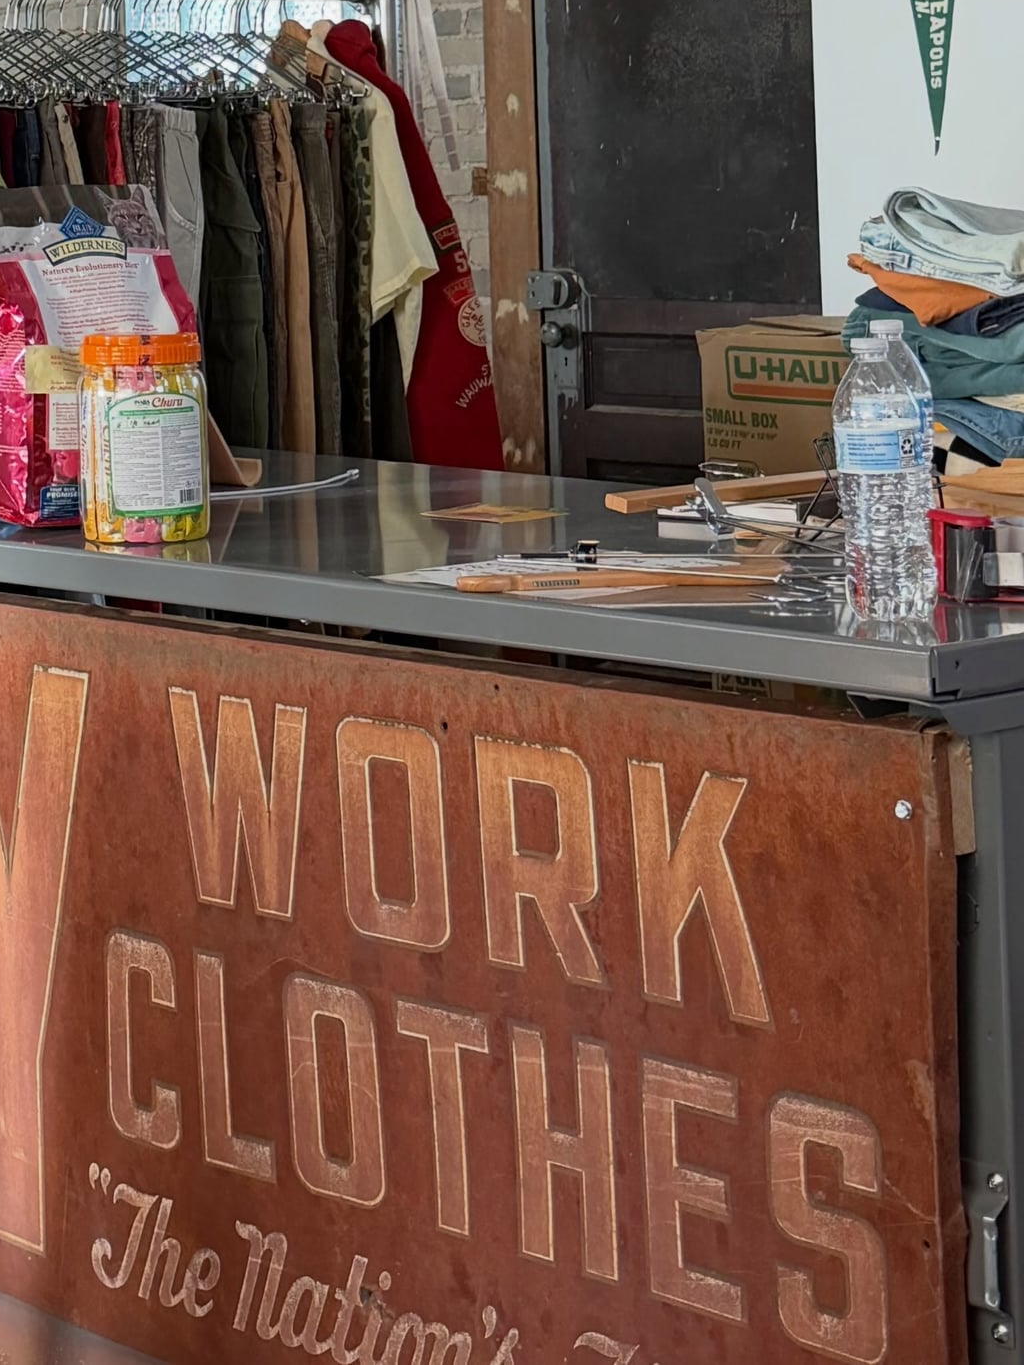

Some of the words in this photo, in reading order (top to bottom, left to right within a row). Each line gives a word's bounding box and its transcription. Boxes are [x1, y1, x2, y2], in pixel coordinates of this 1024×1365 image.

[48, 239, 124, 259] WILDERNESS
[152, 396, 183, 408] Churu
[705, 407, 747, 426] SMALL
[751, 411, 778, 430] BOX
[732, 440, 742, 450] FT
[168, 686, 772, 1030] WORK
[105, 930, 889, 1365] CLOTHES
